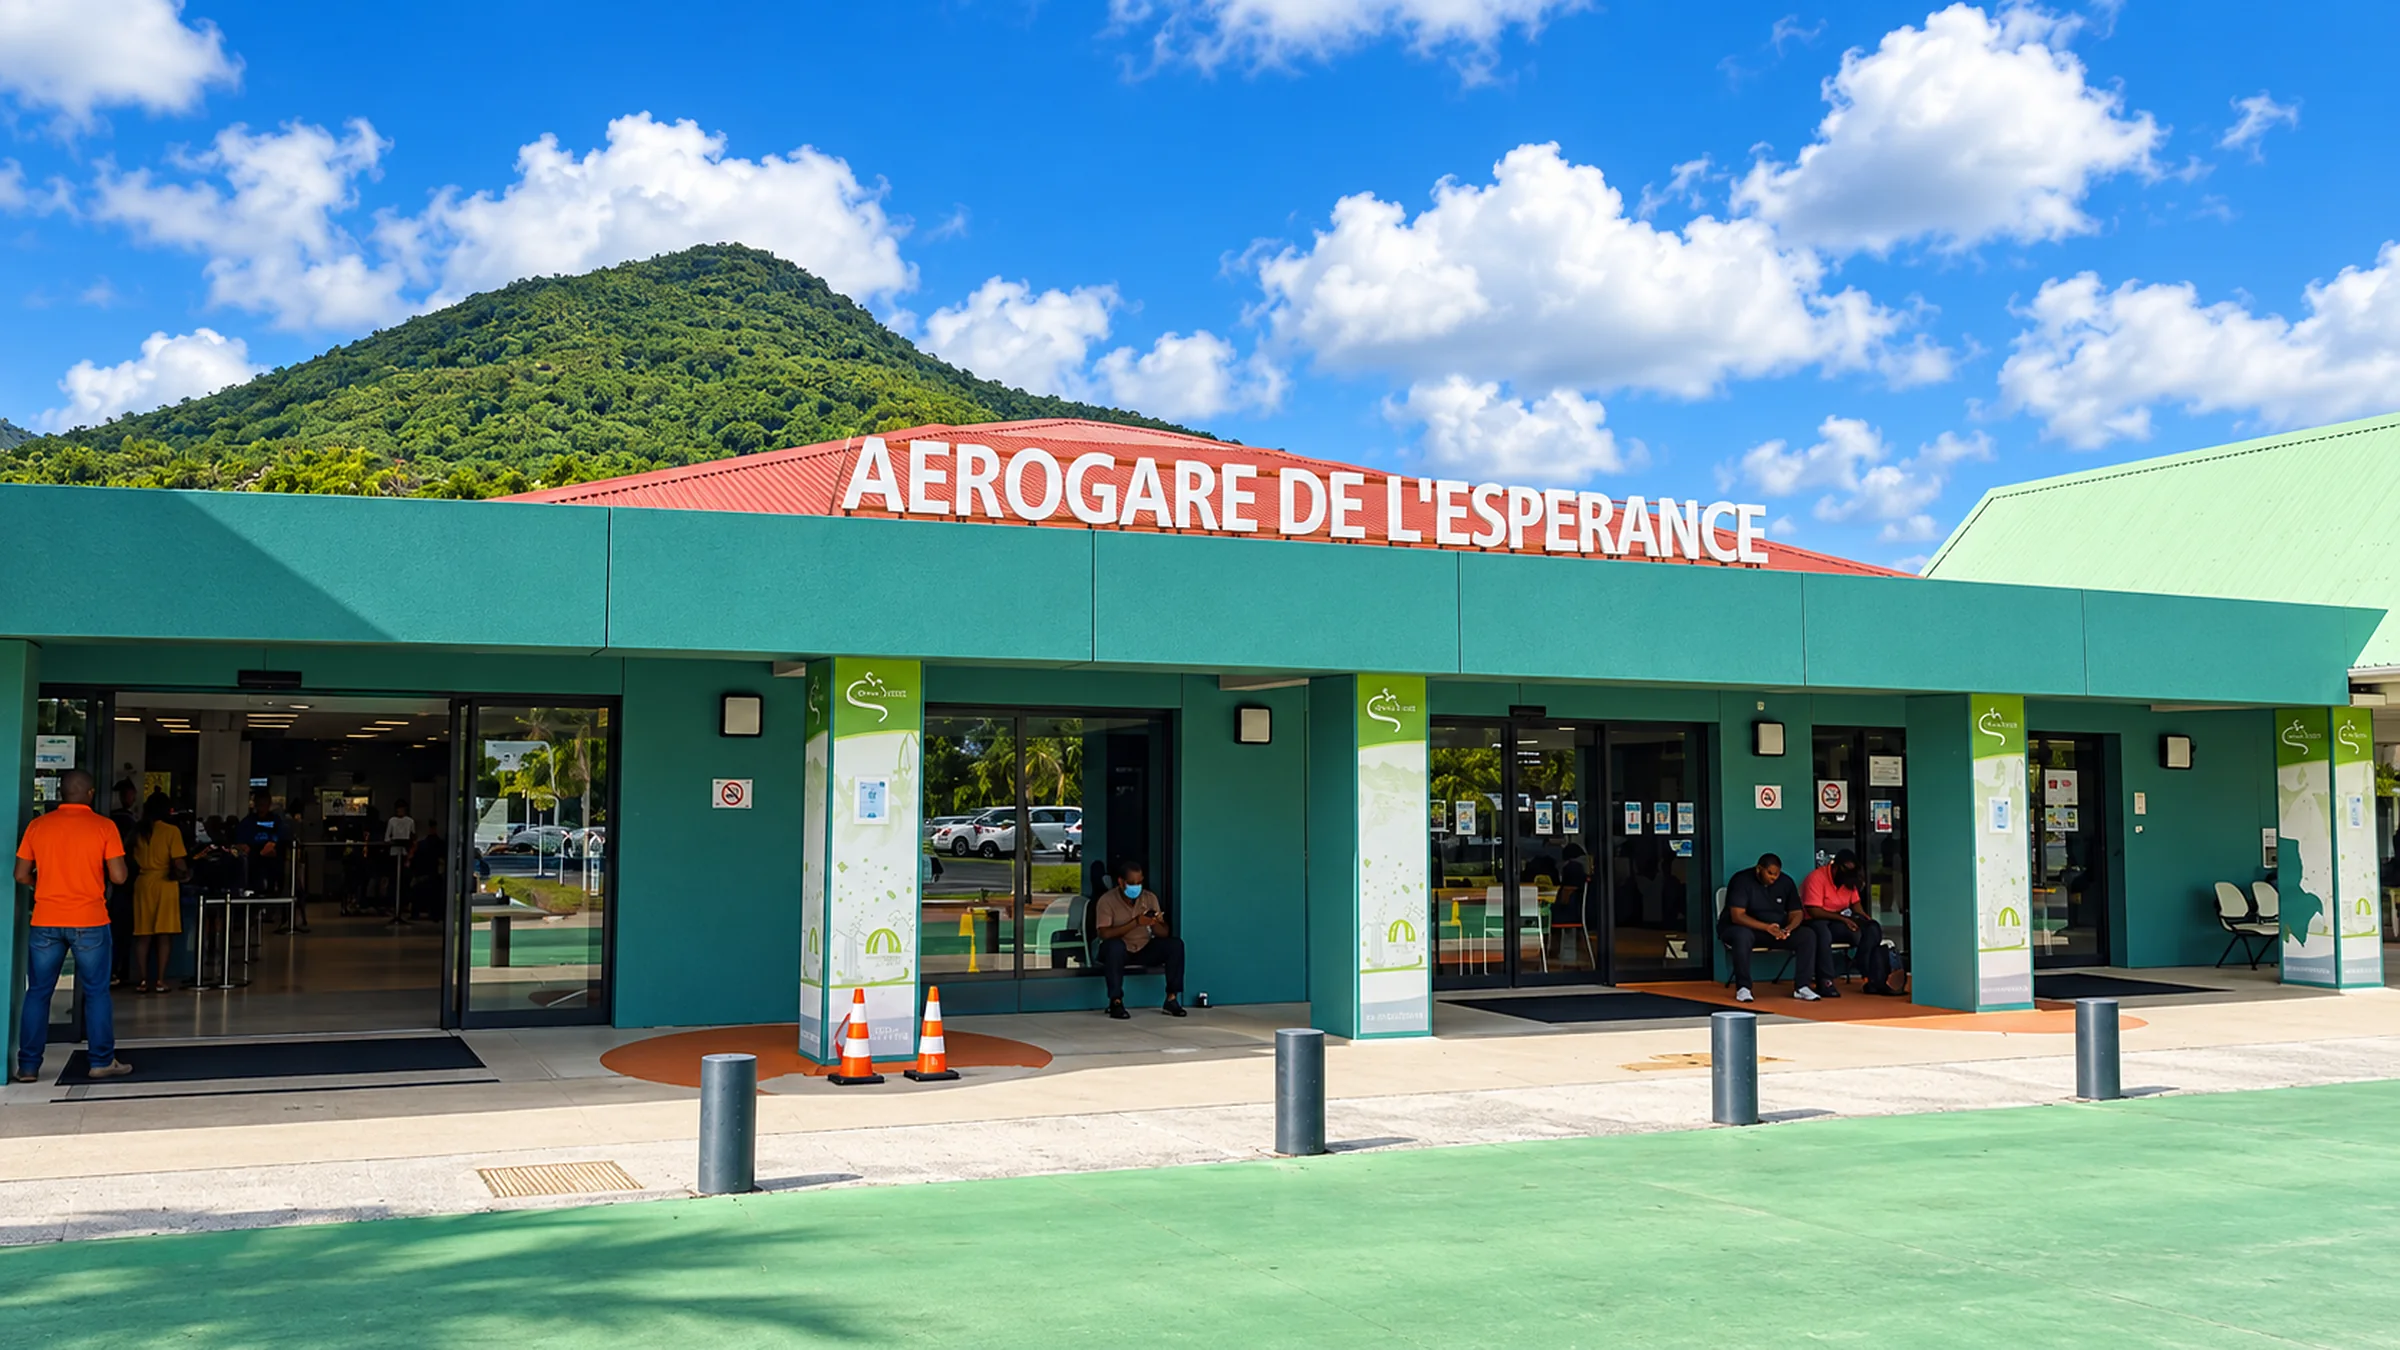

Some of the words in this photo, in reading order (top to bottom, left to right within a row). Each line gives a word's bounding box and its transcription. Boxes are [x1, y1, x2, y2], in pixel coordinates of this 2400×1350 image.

[841, 436, 1258, 533] AEROGARE
[1279, 467, 1367, 539] DE
[1387, 475, 1769, 564] L'ESPERANCE
